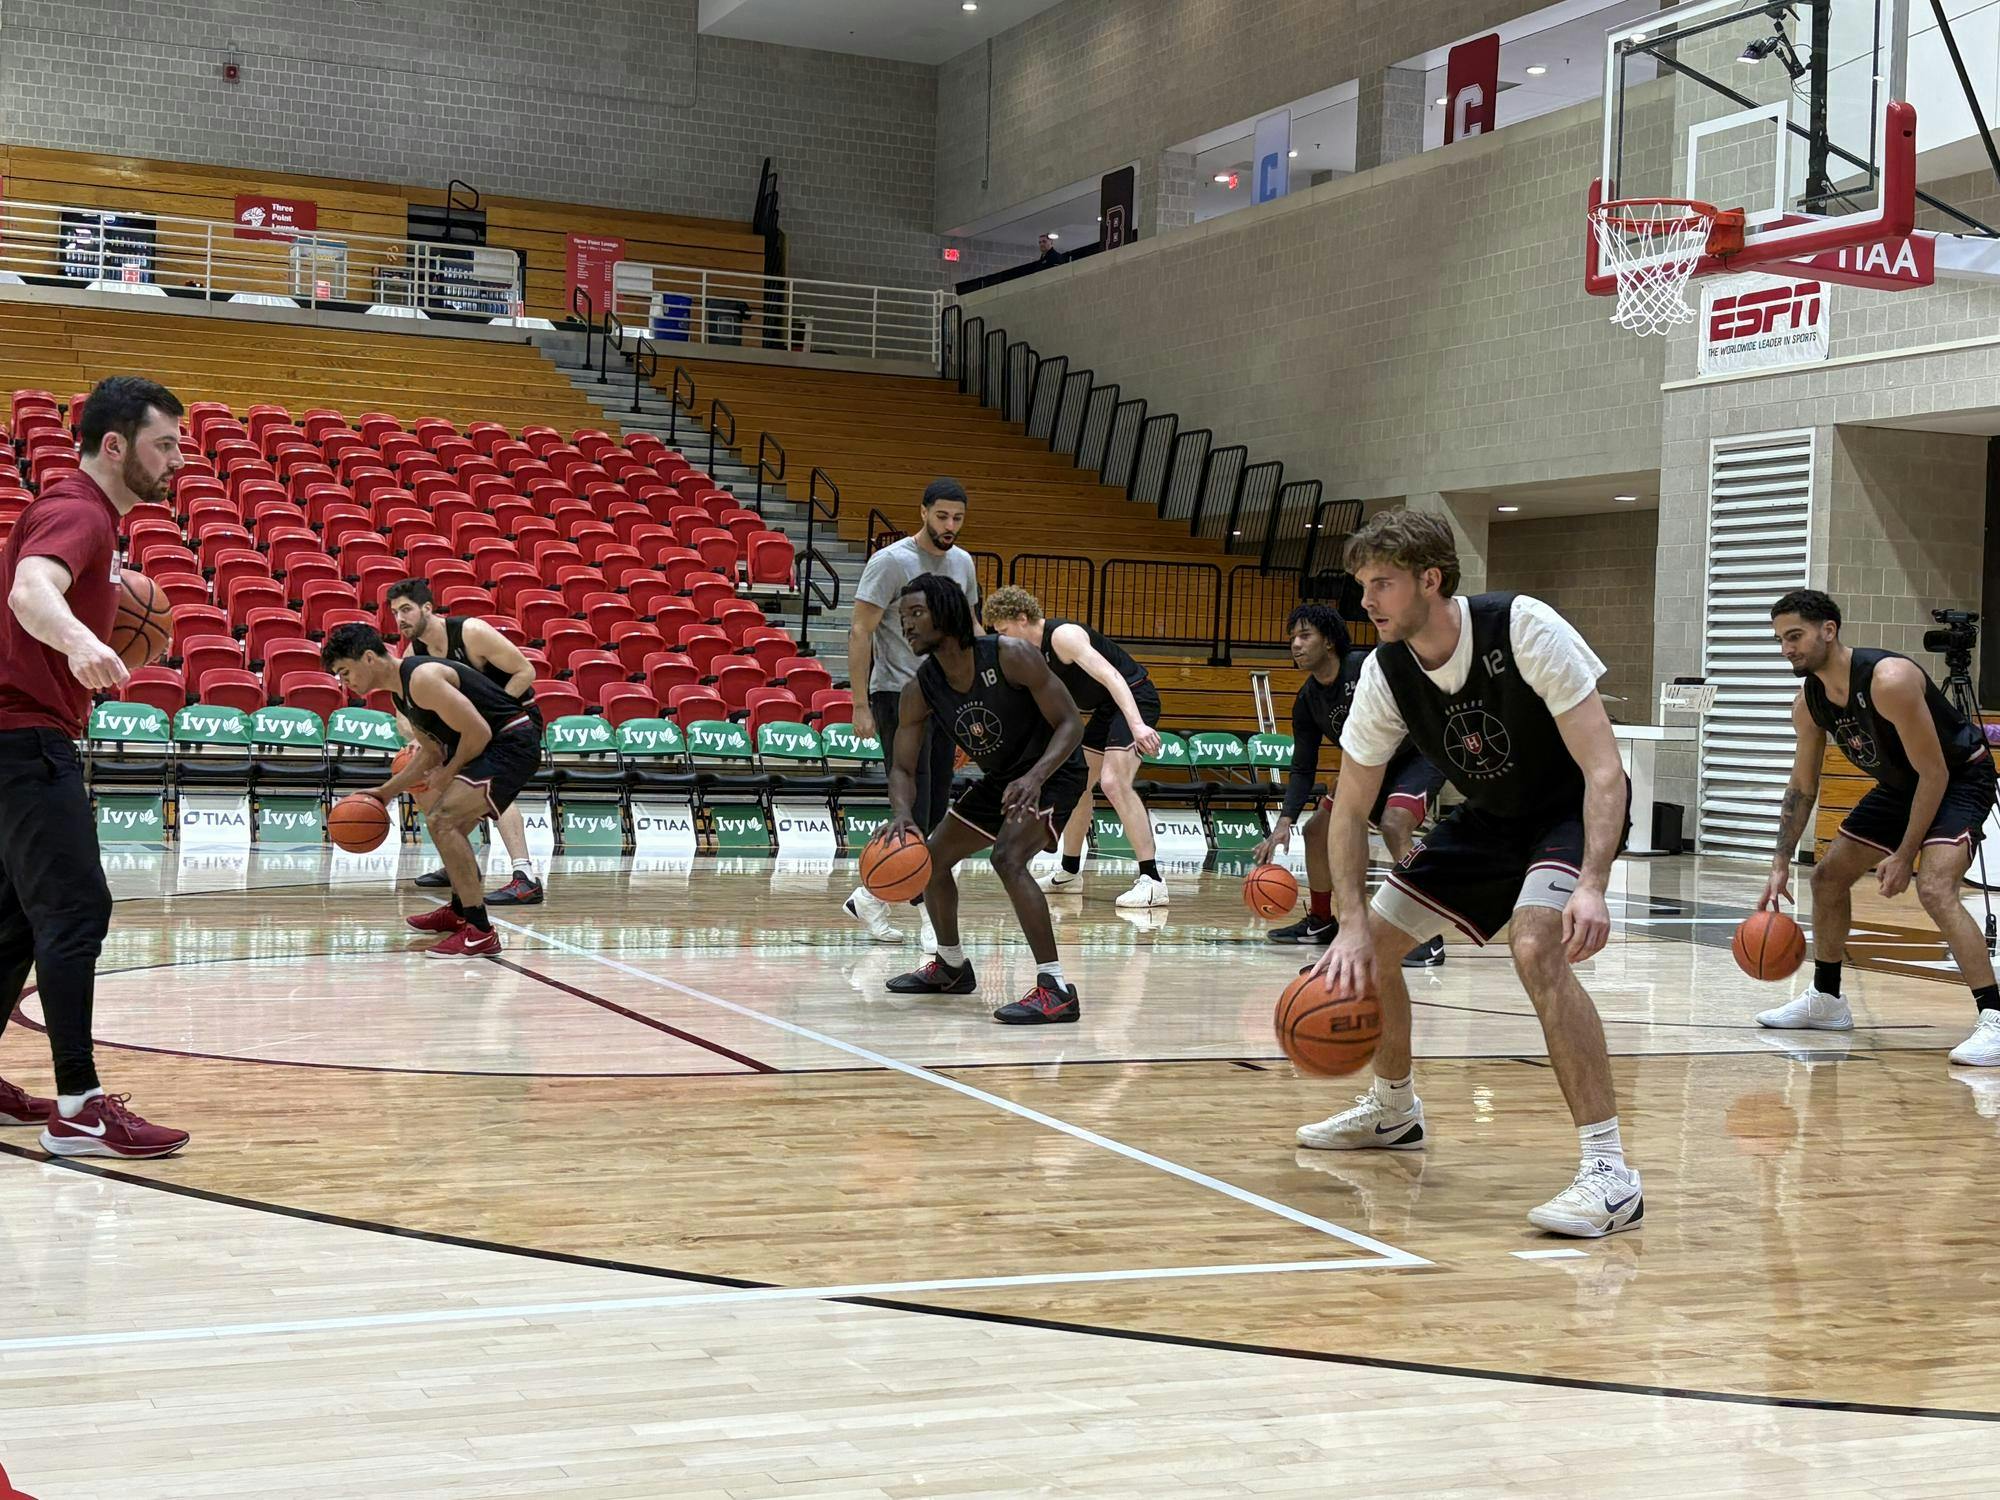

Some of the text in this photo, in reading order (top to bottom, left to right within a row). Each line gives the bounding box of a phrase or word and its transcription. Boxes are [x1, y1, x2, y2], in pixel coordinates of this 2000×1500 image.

[1453, 83, 1484, 142] C
[1260, 152, 1278, 203] C
[271, 213, 292, 222] Point
[272, 203, 294, 213] Three
[1709, 281, 1821, 342] ESPN
[1708, 332, 1817, 357] THE WORLDWIDE LEADER IN SPORTS
[1482, 649, 1505, 678] 12
[980, 668, 998, 688] 18
[96, 711, 138, 736] Ivy
[181, 712, 222, 737] Ivy
[255, 714, 295, 739] Ivy
[334, 714, 374, 740] Ivy
[553, 725, 589, 747] Ivy
[623, 727, 658, 749] Ivy
[692, 727, 727, 750] Ivy
[764, 729, 798, 752] Ivy
[828, 730, 861, 753] Ivy
[1194, 740, 1225, 760] Ivy
[1254, 740, 1286, 761] Ivy
[101, 807, 138, 829] Ivy
[203, 812, 245, 826] TIAA
[262, 809, 297, 830] Ivy
[525, 817, 548, 829] AA
[567, 813, 598, 833] Ivy
[653, 819, 691, 831] TIAA
[716, 816, 746, 835] Ivy
[793, 820, 830, 832] TIAA
[849, 816, 874, 836] Ivy
[1097, 819, 1124, 838] Ivy
[1168, 824, 1202, 835] TIAA
[1216, 820, 1245, 839] Ivy
